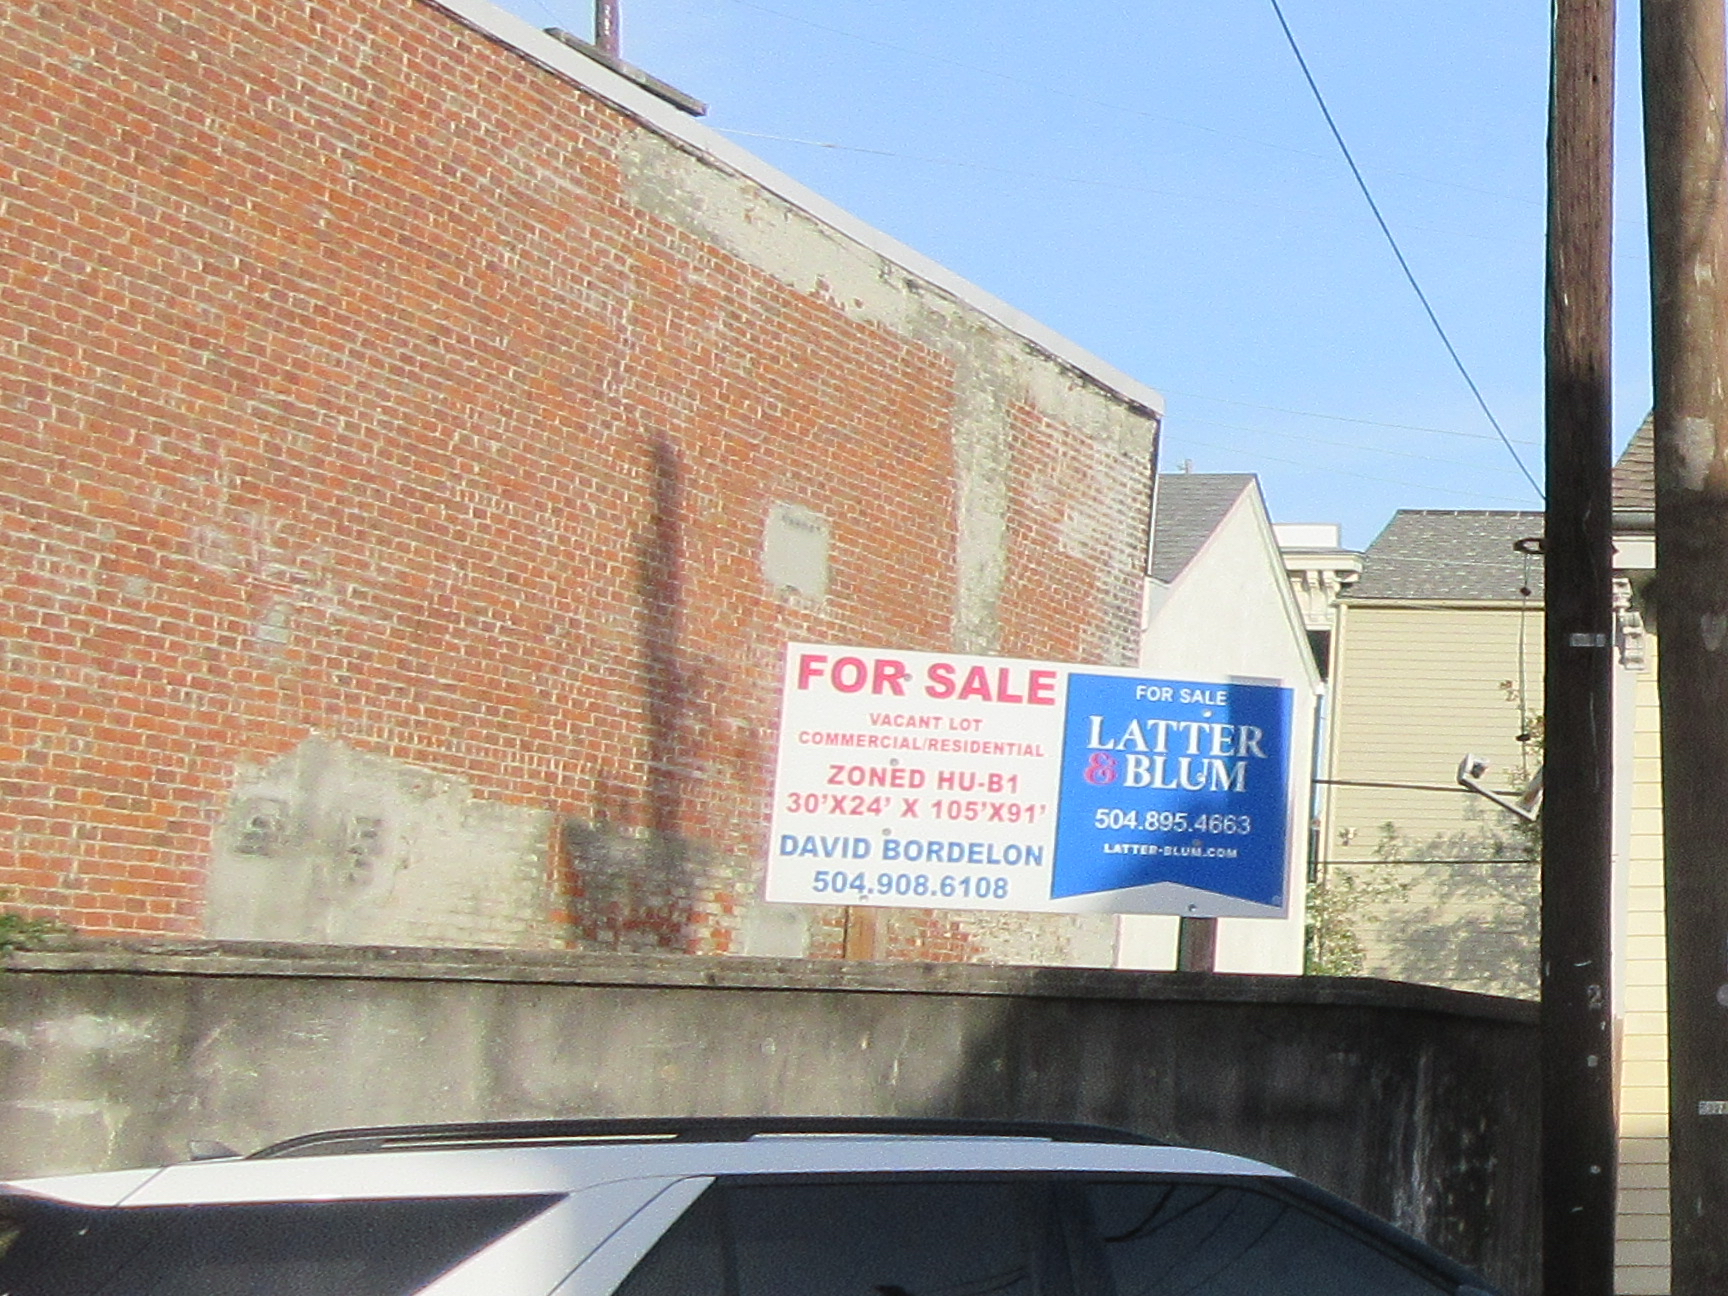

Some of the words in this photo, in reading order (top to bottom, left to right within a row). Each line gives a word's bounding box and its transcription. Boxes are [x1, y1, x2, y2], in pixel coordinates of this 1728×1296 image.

[797, 654, 908, 696] FOR
[924, 662, 1058, 705] SALE
[1135, 685, 1173, 702] FOR
[1180, 688, 1228, 706] SALE
[870, 712, 943, 730] VACANT
[950, 717, 983, 732] LOT
[798, 731, 1045, 758] COMMERCIAL/RESIDENTIAL
[1086, 715, 1268, 758] LATTER
[827, 764, 926, 790] ZONED
[936, 770, 1019, 794] HU-B1
[1083, 752, 1118, 785] &
[1123, 754, 1249, 793] BLUM
[901, 798, 919, 819] X
[1094, 808, 1252, 835] 504.895.4663
[779, 834, 872, 860] DAVID
[882, 838, 1045, 867] BORDELON
[1103, 843, 1238, 858] LATTER-BLUM.COM
[812, 870, 1010, 900] 504.908.6108
